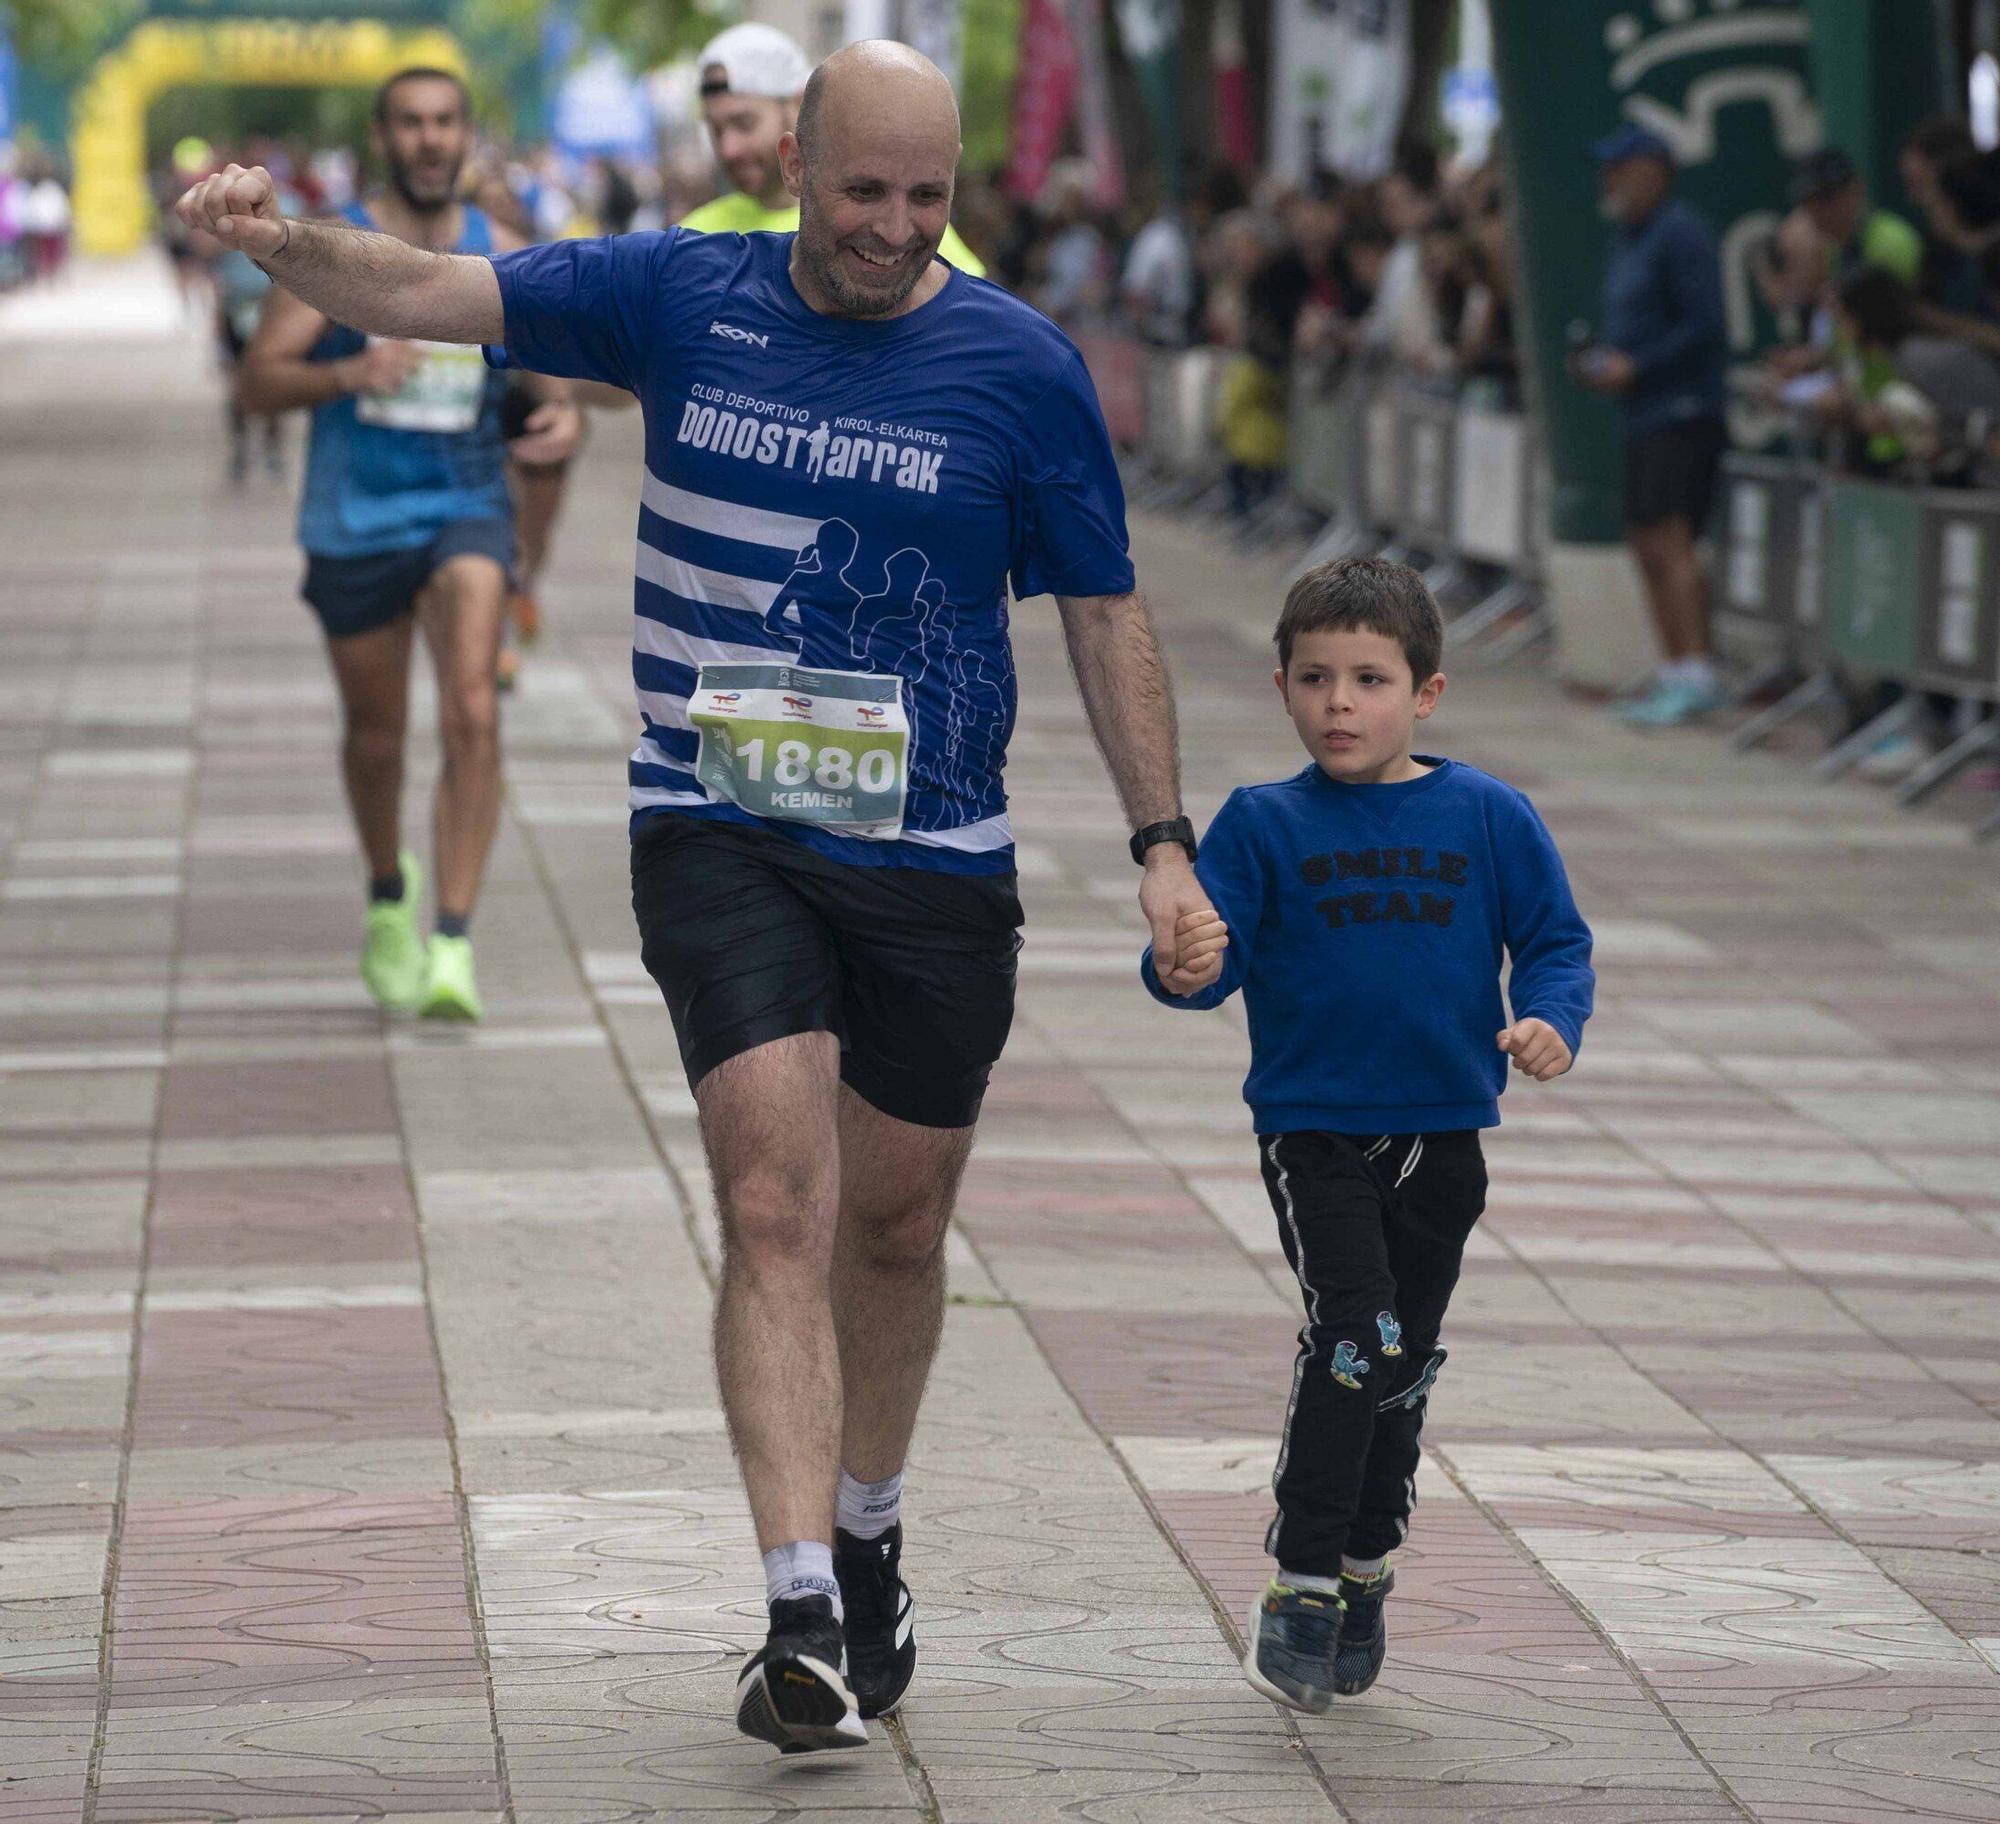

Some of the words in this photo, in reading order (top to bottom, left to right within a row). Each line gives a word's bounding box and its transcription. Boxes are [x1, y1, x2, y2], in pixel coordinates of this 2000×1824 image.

[691, 383, 723, 403] CLUB
[725, 392, 810, 423] DEPORTIVO
[834, 416, 949, 448] KIROL-ELKARTEA
[736, 738, 897, 794] 1880
[770, 791, 853, 809] KEMEN
[1301, 846, 1469, 887] SMILE
[1316, 892, 1455, 928] TEAM
